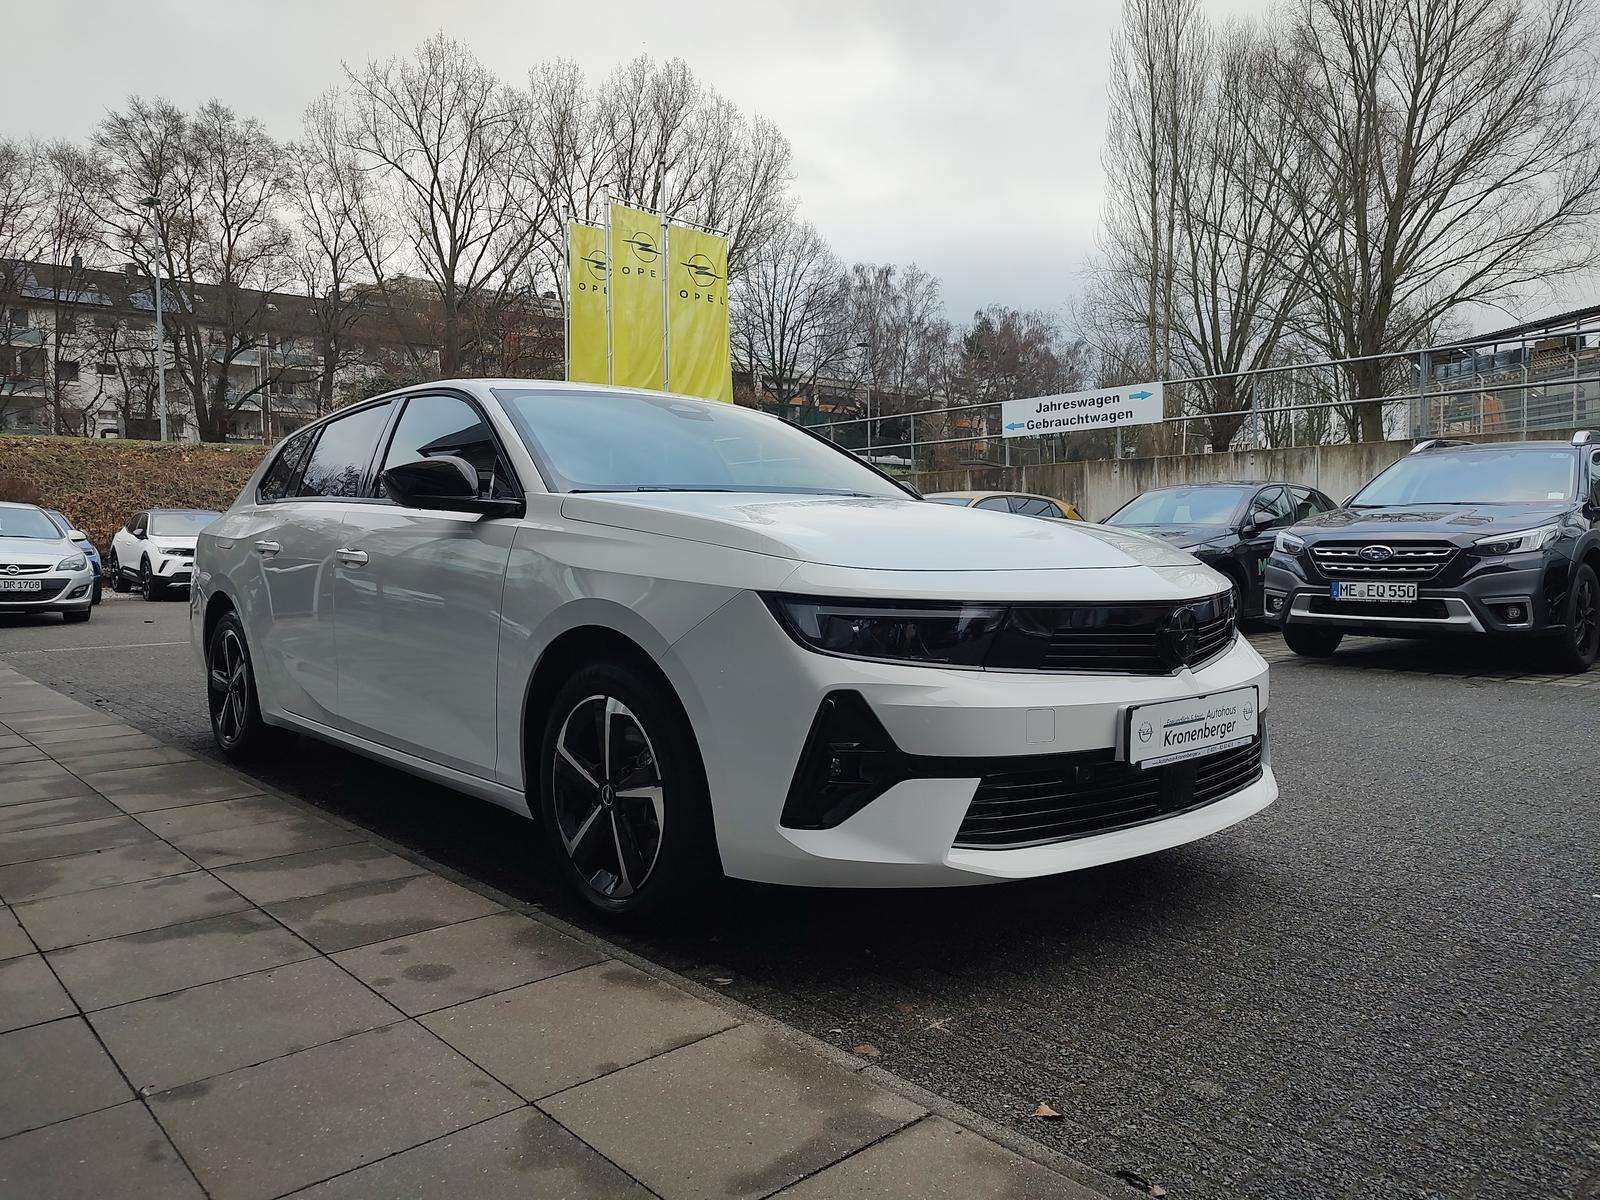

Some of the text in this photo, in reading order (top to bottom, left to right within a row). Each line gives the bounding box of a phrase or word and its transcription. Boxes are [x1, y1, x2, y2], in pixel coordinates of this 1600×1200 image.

[621, 266, 657, 278] OPE
[578, 282, 608, 294] OPE
[679, 289, 724, 306] OPEL
[1035, 393, 1121, 414] Jahreswagen
[1026, 409, 1134, 431] Gebrauchtwagen
[3, 580, 40, 589] DR 1708
[1339, 583, 1416, 598] ME EQ 550
[1205, 704, 1237, 721] Autohaus
[1163, 719, 1237, 747] Kronenberger
